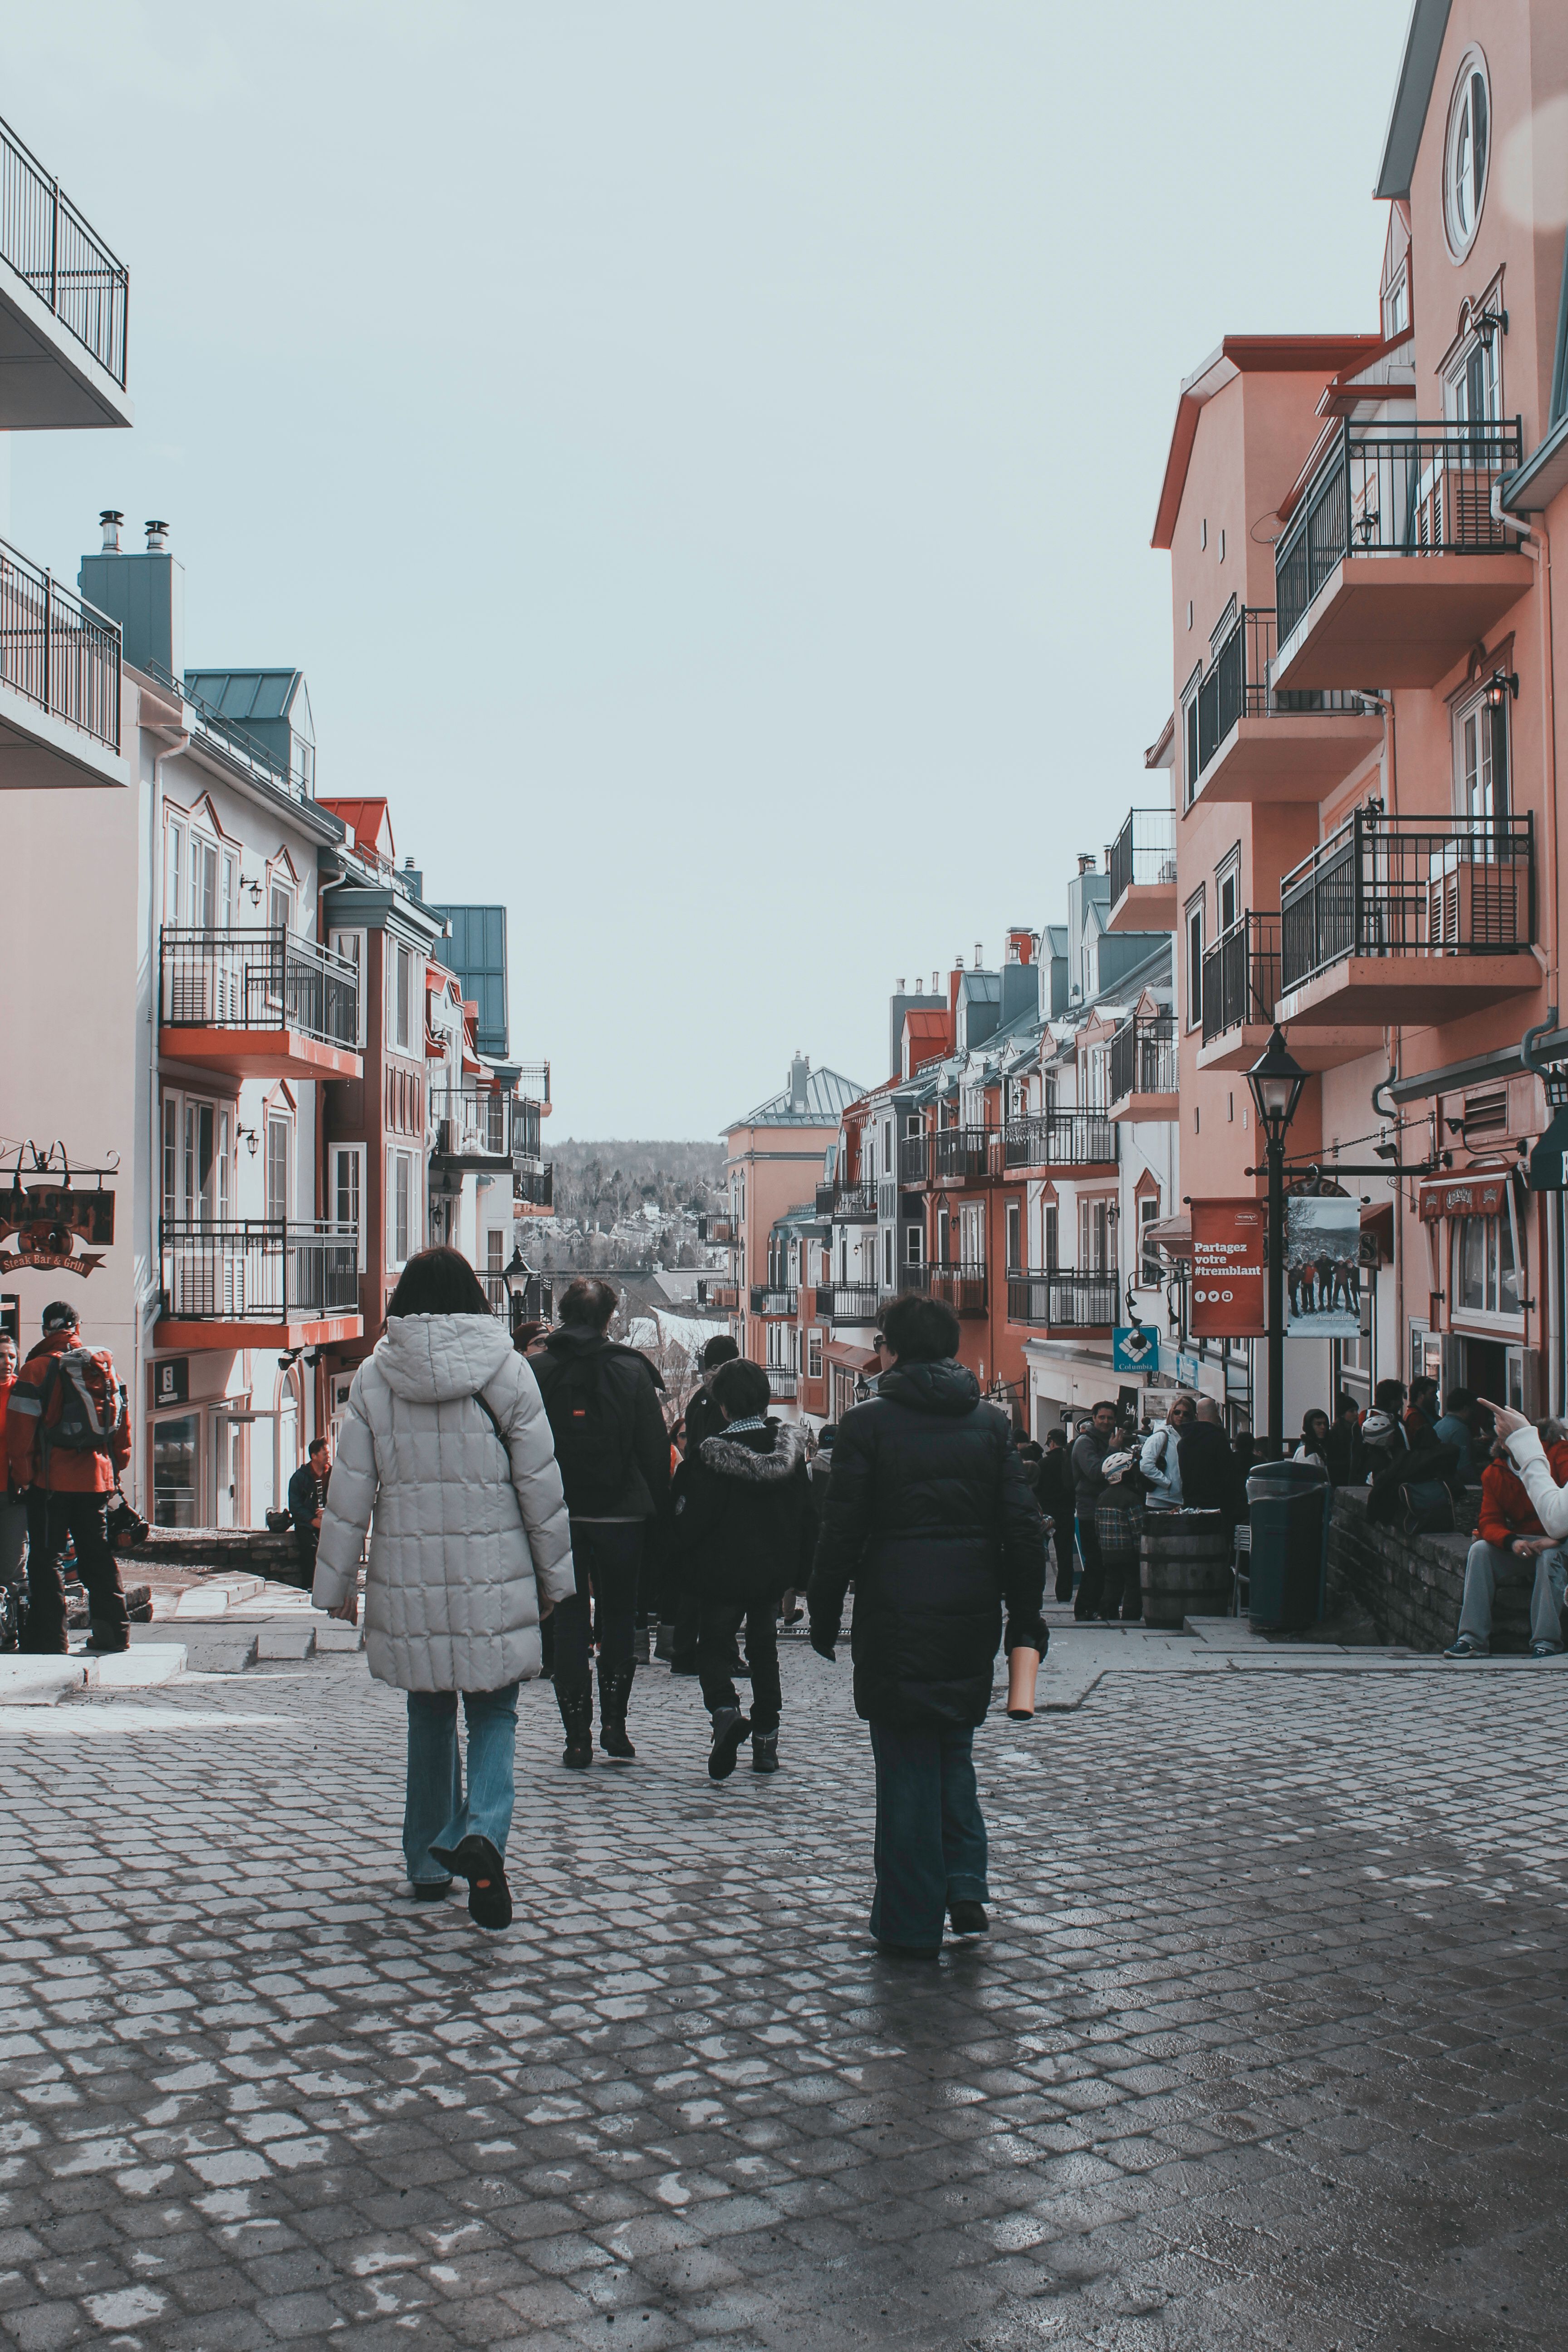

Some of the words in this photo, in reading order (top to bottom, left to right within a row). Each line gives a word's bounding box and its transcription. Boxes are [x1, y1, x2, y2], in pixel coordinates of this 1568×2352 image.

[1194, 1242, 1247, 1254] Partagez
[4, 1255, 31, 1269] Steak
[34, 1254, 51, 1264] Bar
[54, 1255, 61, 1265] &
[64, 1258, 85, 1272] Grill
[1194, 1255, 1227, 1264] votre
[1195, 1266, 1261, 1276] #tremblant
